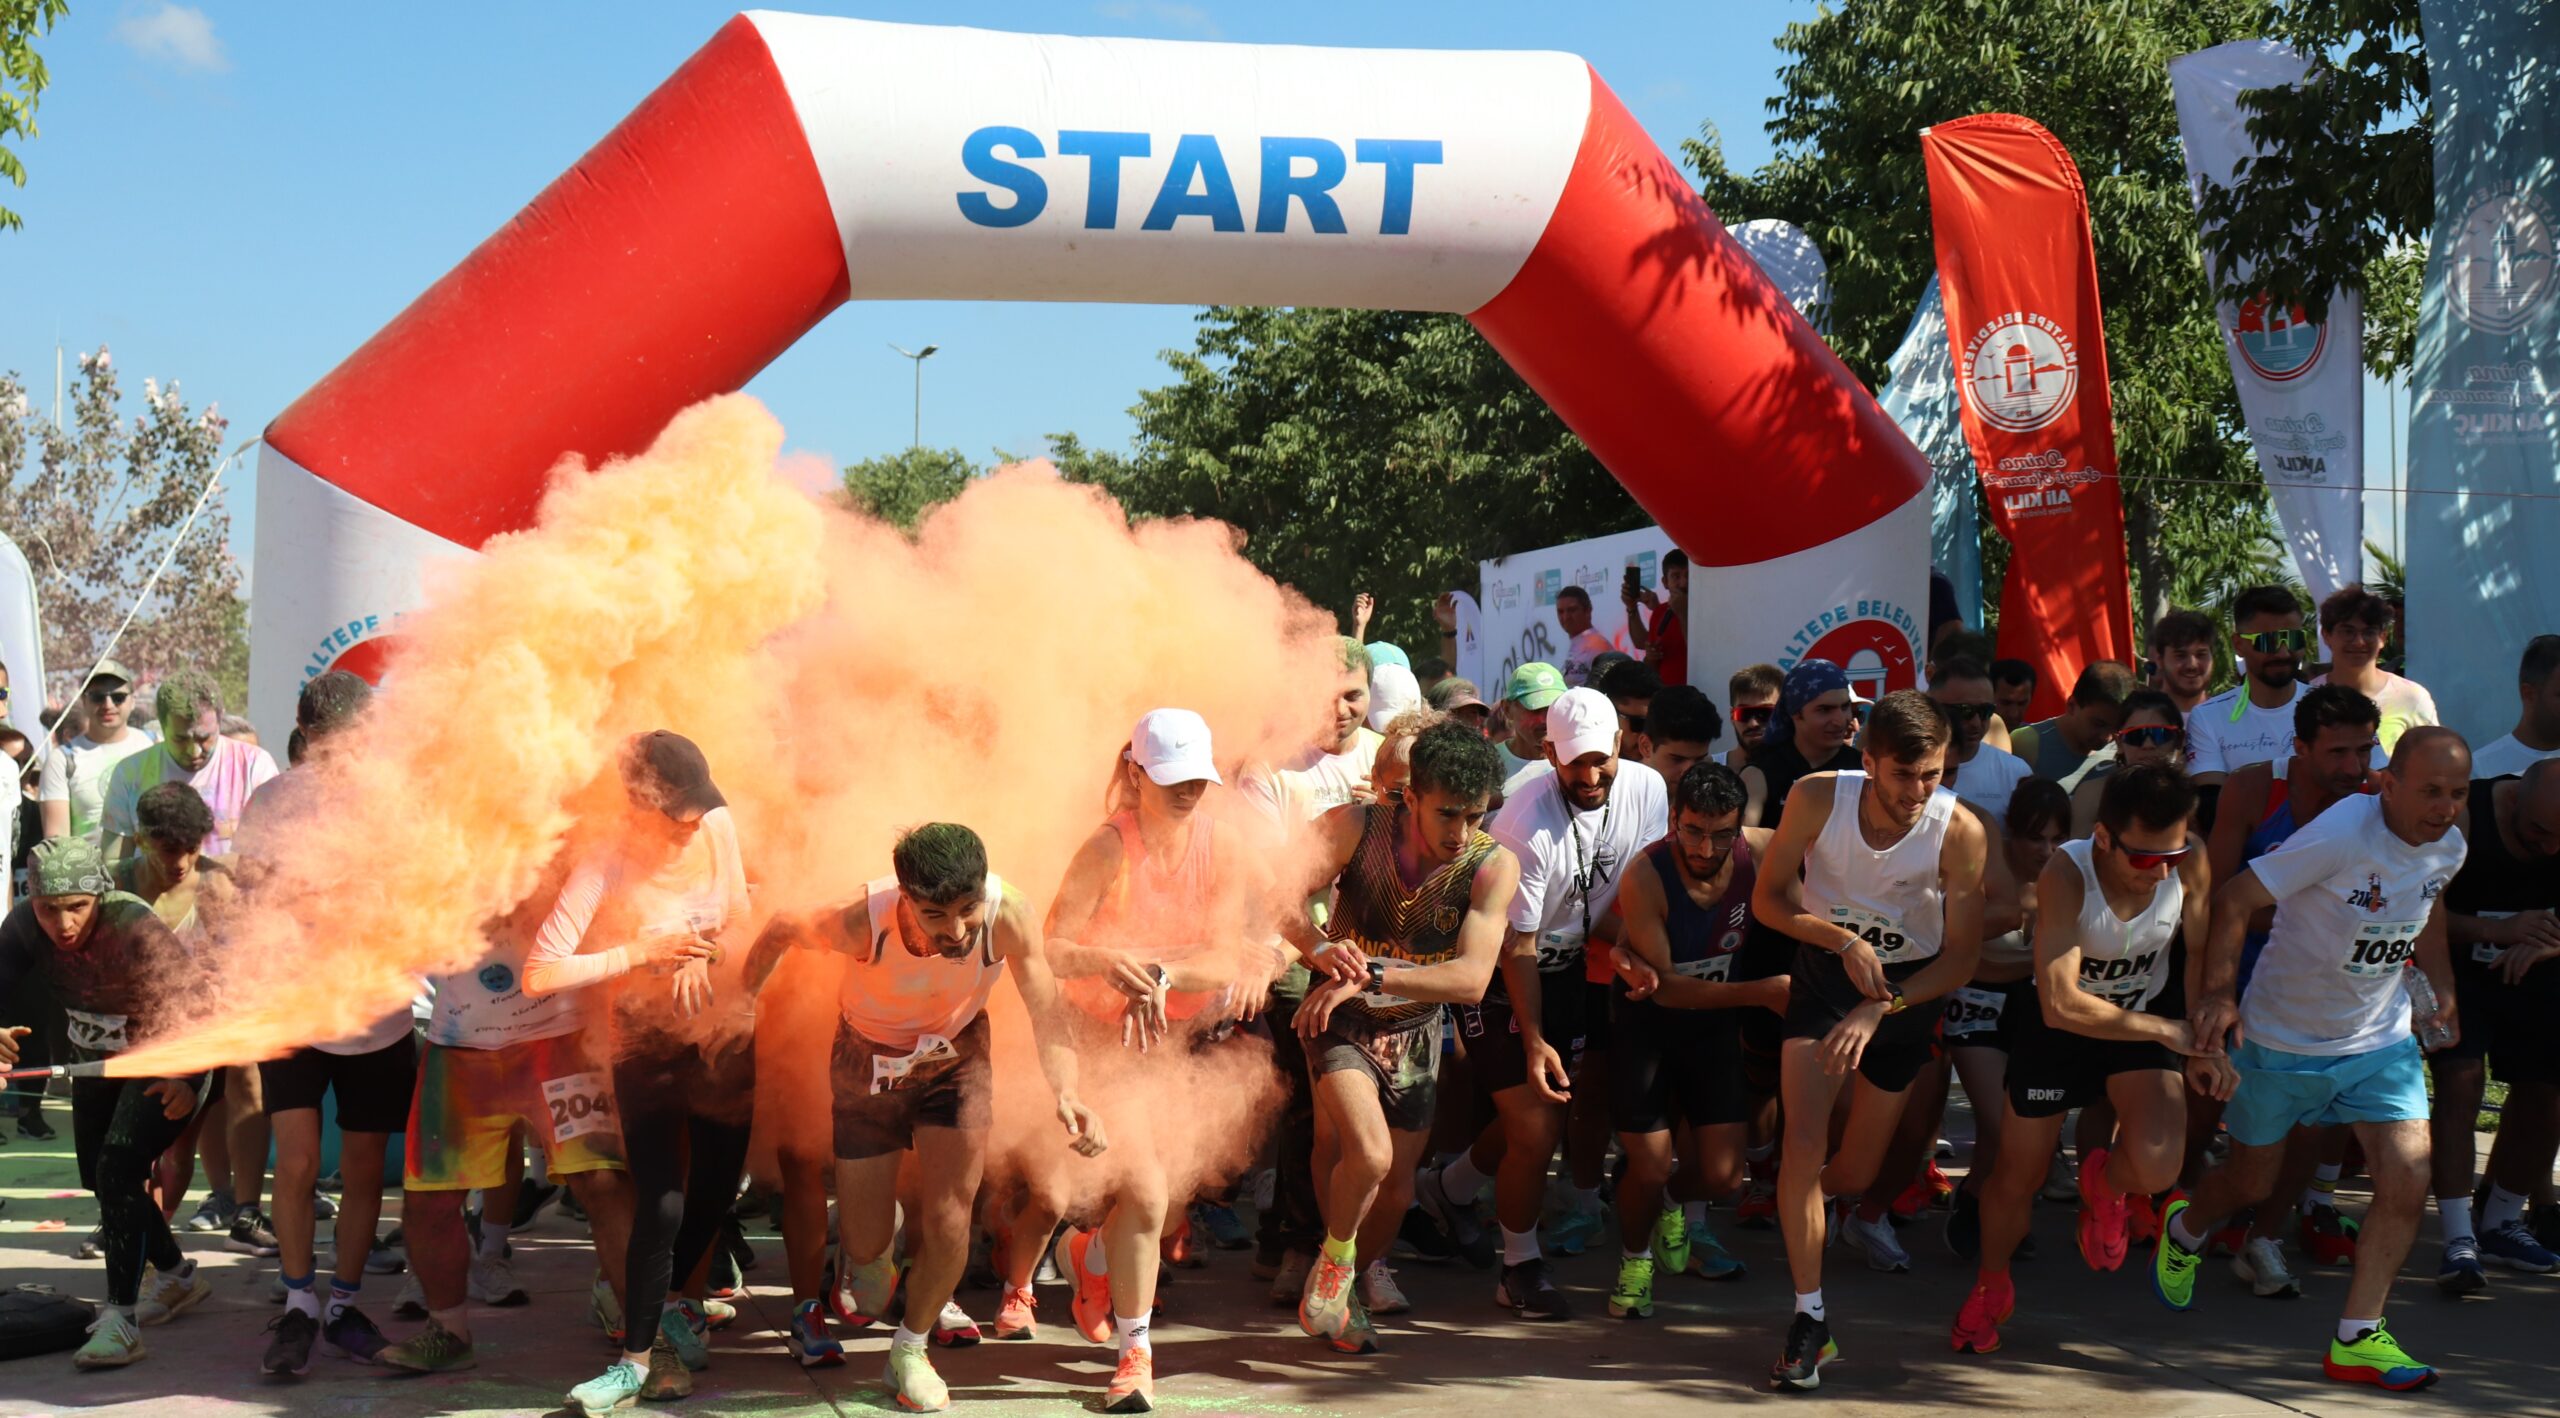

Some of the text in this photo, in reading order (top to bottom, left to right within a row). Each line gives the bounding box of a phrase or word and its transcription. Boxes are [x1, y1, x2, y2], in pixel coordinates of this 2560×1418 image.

[956, 125, 1444, 235] START
[1777, 605, 1849, 673] ALTEPE
[1832, 921, 1905, 952] 49
